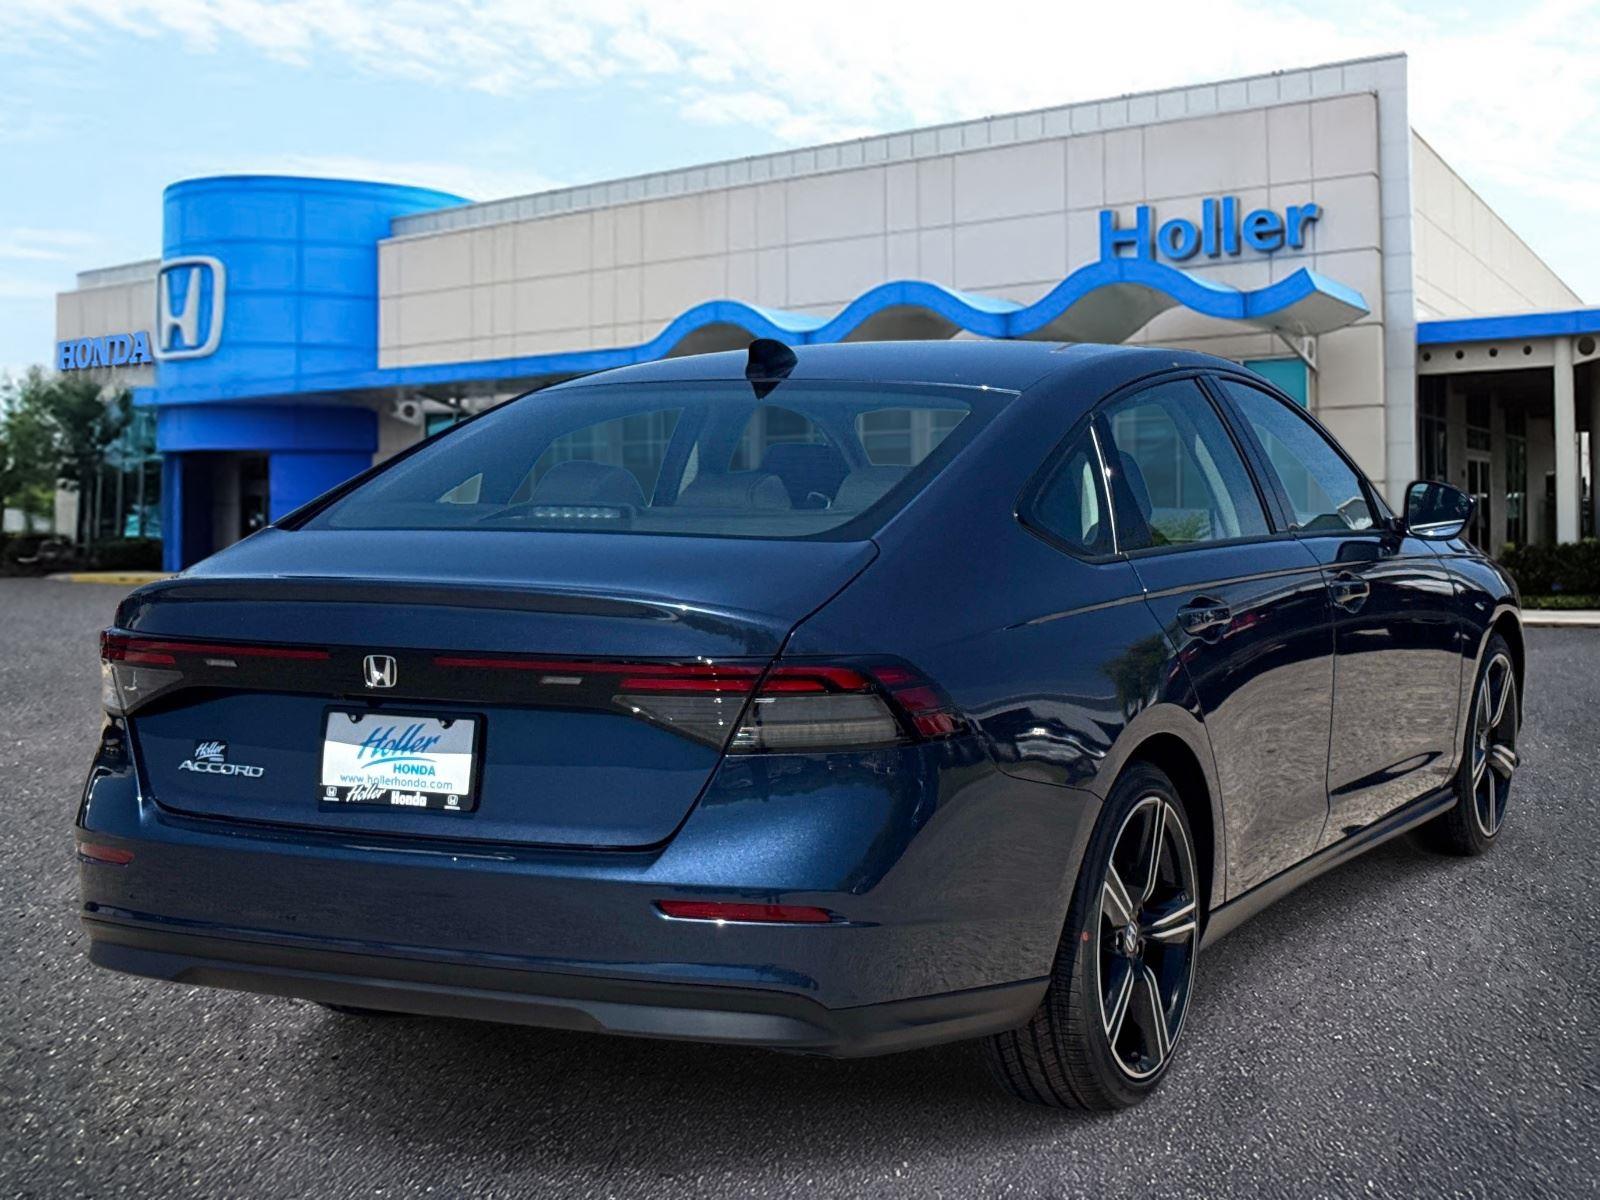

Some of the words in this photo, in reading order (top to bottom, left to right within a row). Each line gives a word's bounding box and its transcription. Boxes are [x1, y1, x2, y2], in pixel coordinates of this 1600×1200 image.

[1099, 196, 1322, 261] Holler
[57, 331, 153, 371] HONDA
[356, 723, 442, 759] Holler
[178, 760, 264, 778] ACCORD
[392, 763, 436, 777] HONDA
[339, 773, 454, 791] www.hollerhonda.com
[345, 784, 388, 803] Holler
[390, 790, 428, 807] Honda
